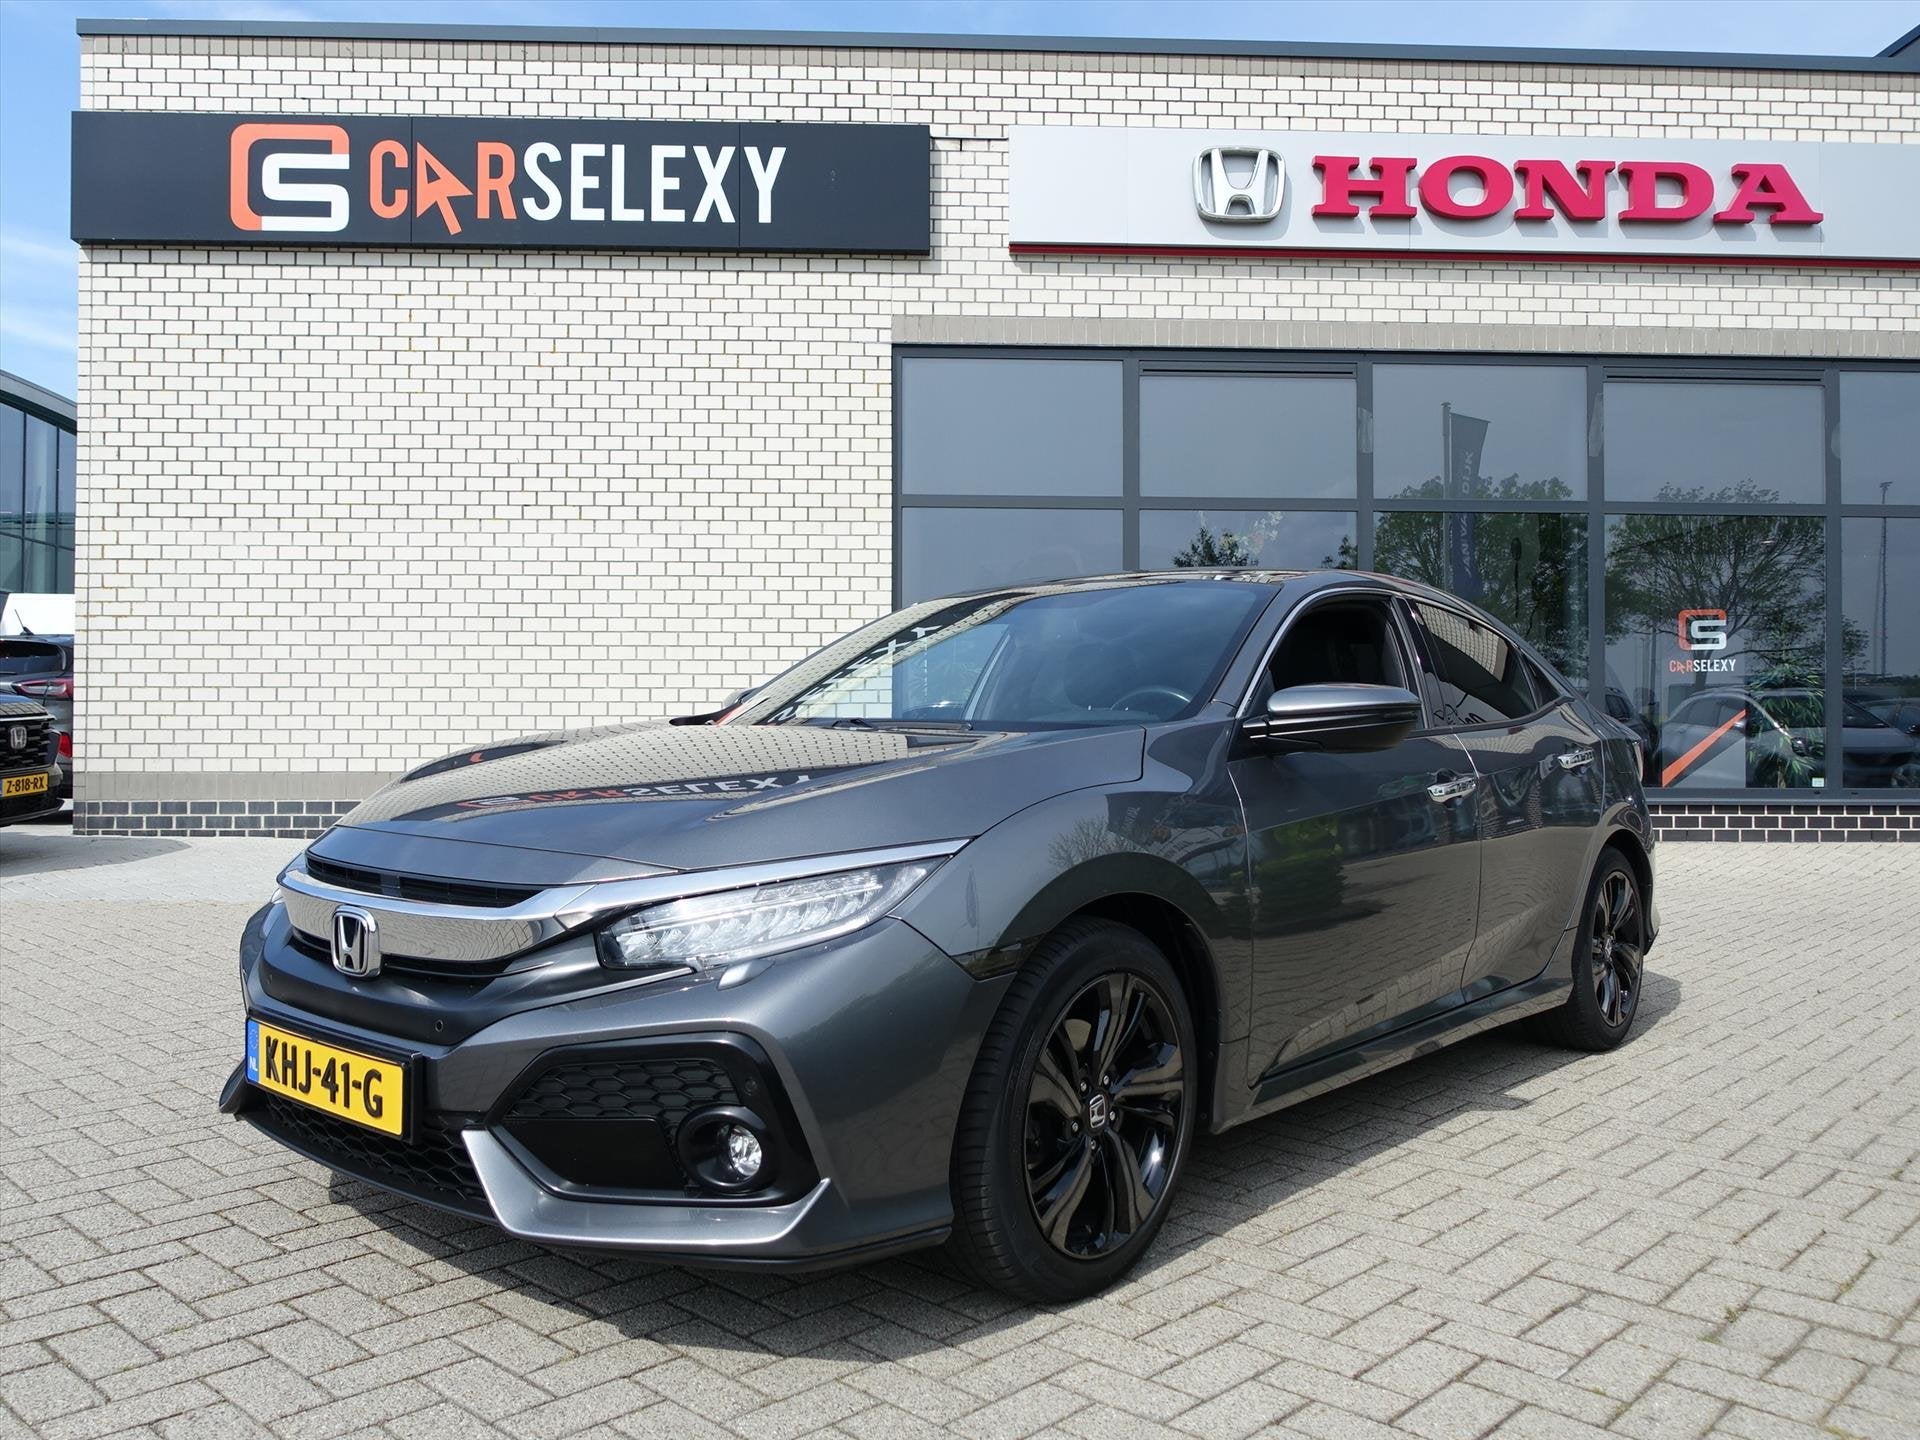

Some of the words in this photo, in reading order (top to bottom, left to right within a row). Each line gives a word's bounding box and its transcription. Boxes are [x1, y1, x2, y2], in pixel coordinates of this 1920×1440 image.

[369, 140, 787, 235] CARSELEXY
[1312, 154, 1824, 226] HONDA
[1669, 659, 1736, 674] CARSELEXY
[6, 777, 45, 794] Z-818-RX
[265, 1035, 383, 1118] KHJ-41-G
